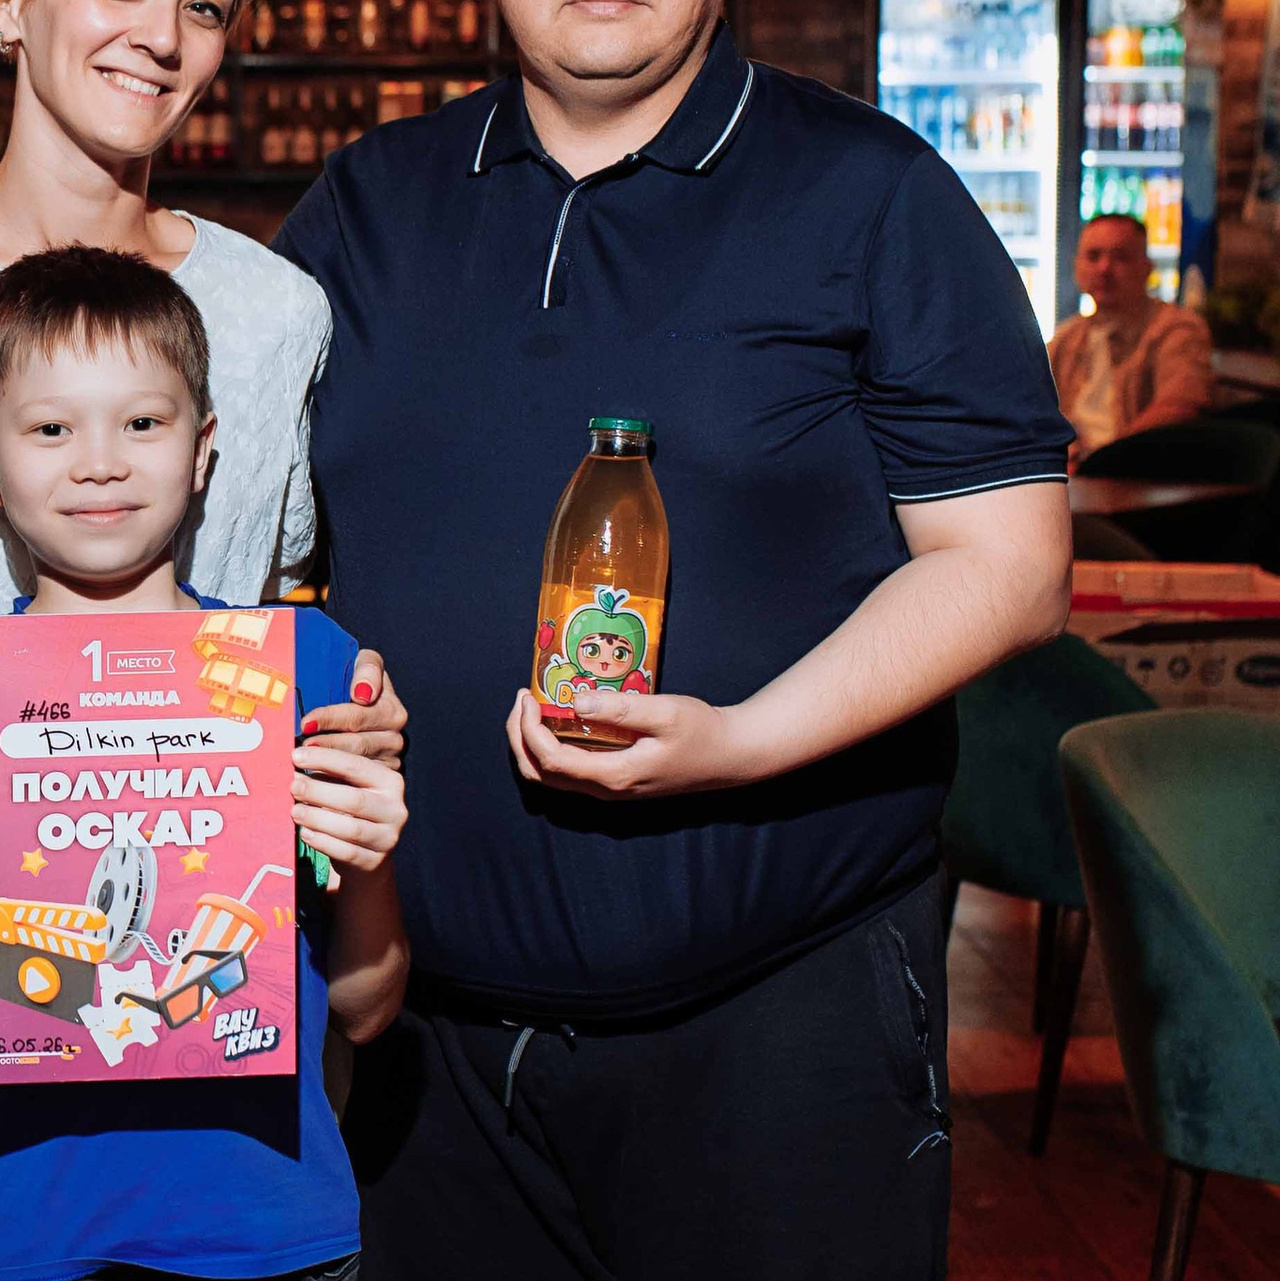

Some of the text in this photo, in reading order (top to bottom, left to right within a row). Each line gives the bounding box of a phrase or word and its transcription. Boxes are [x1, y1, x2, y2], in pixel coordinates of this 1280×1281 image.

[81, 640, 162, 682] 1 МЕСТО
[19, 700, 71, 722] #466
[79, 689, 180, 708] КОМАНДА
[39, 727, 215, 762] Dilkin park
[12, 766, 250, 803] ПОЛУЧИЛА
[37, 809, 224, 851] ОСКАР
[213, 1007, 258, 1040] ВАУ
[225, 1025, 277, 1057] КВИЗ
